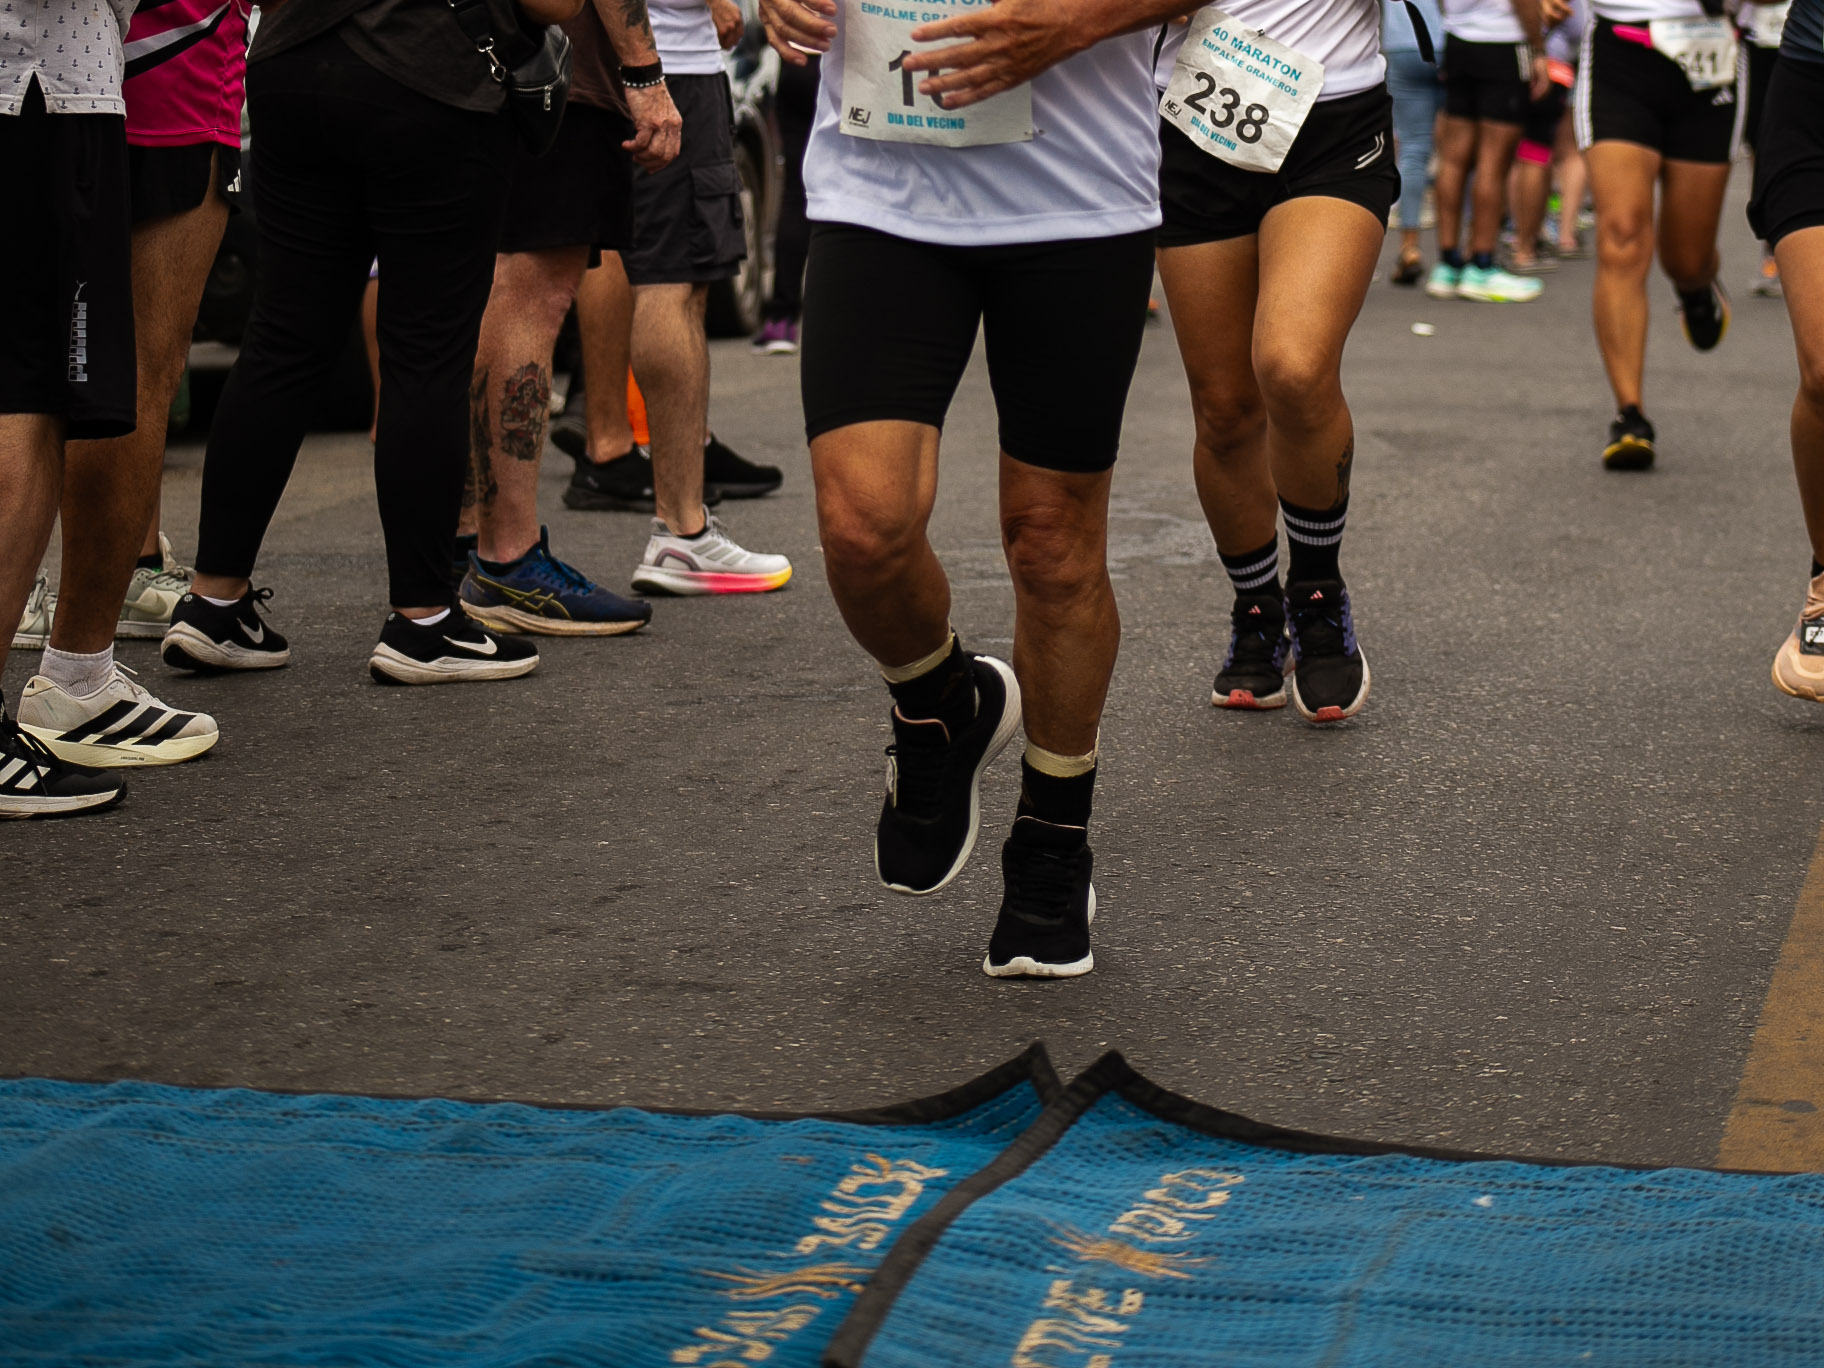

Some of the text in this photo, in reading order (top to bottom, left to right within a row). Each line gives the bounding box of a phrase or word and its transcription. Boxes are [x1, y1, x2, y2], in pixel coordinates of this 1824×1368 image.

[861, 2, 917, 22] EMPALME
[1201, 38, 1298, 97] EMPALME GRANEROS
[1212, 26, 1302, 82] 40 MARATON
[887, 112, 966, 130] DIA DEL VECINO
[1183, 71, 1270, 144] 238
[1199, 121, 1211, 136] DEL
[1210, 130, 1238, 151] VECINO
[68, 301, 88, 382] PUMA
